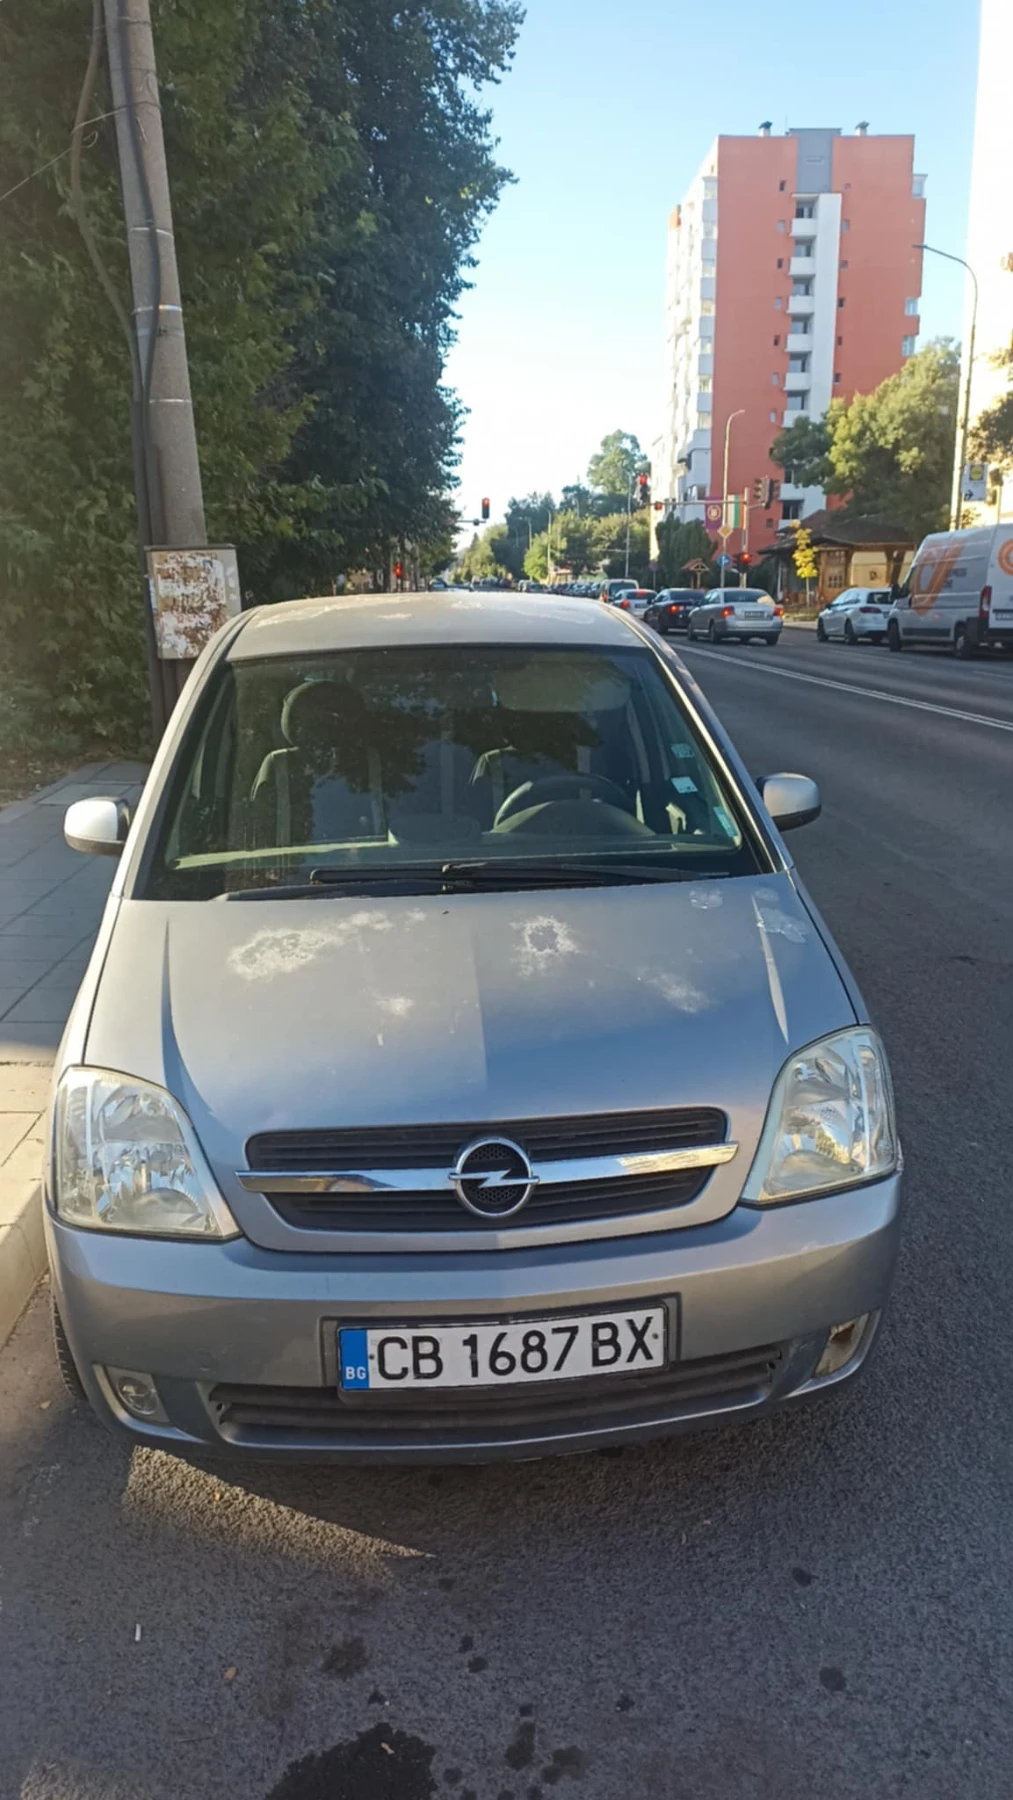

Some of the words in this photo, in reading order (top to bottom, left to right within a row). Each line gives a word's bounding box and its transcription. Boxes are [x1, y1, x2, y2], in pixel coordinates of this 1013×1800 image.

[377, 1335, 444, 1380] CB
[462, 1325, 579, 1378] 1687
[591, 1316, 654, 1367] BX
[345, 1366, 367, 1380] BG
